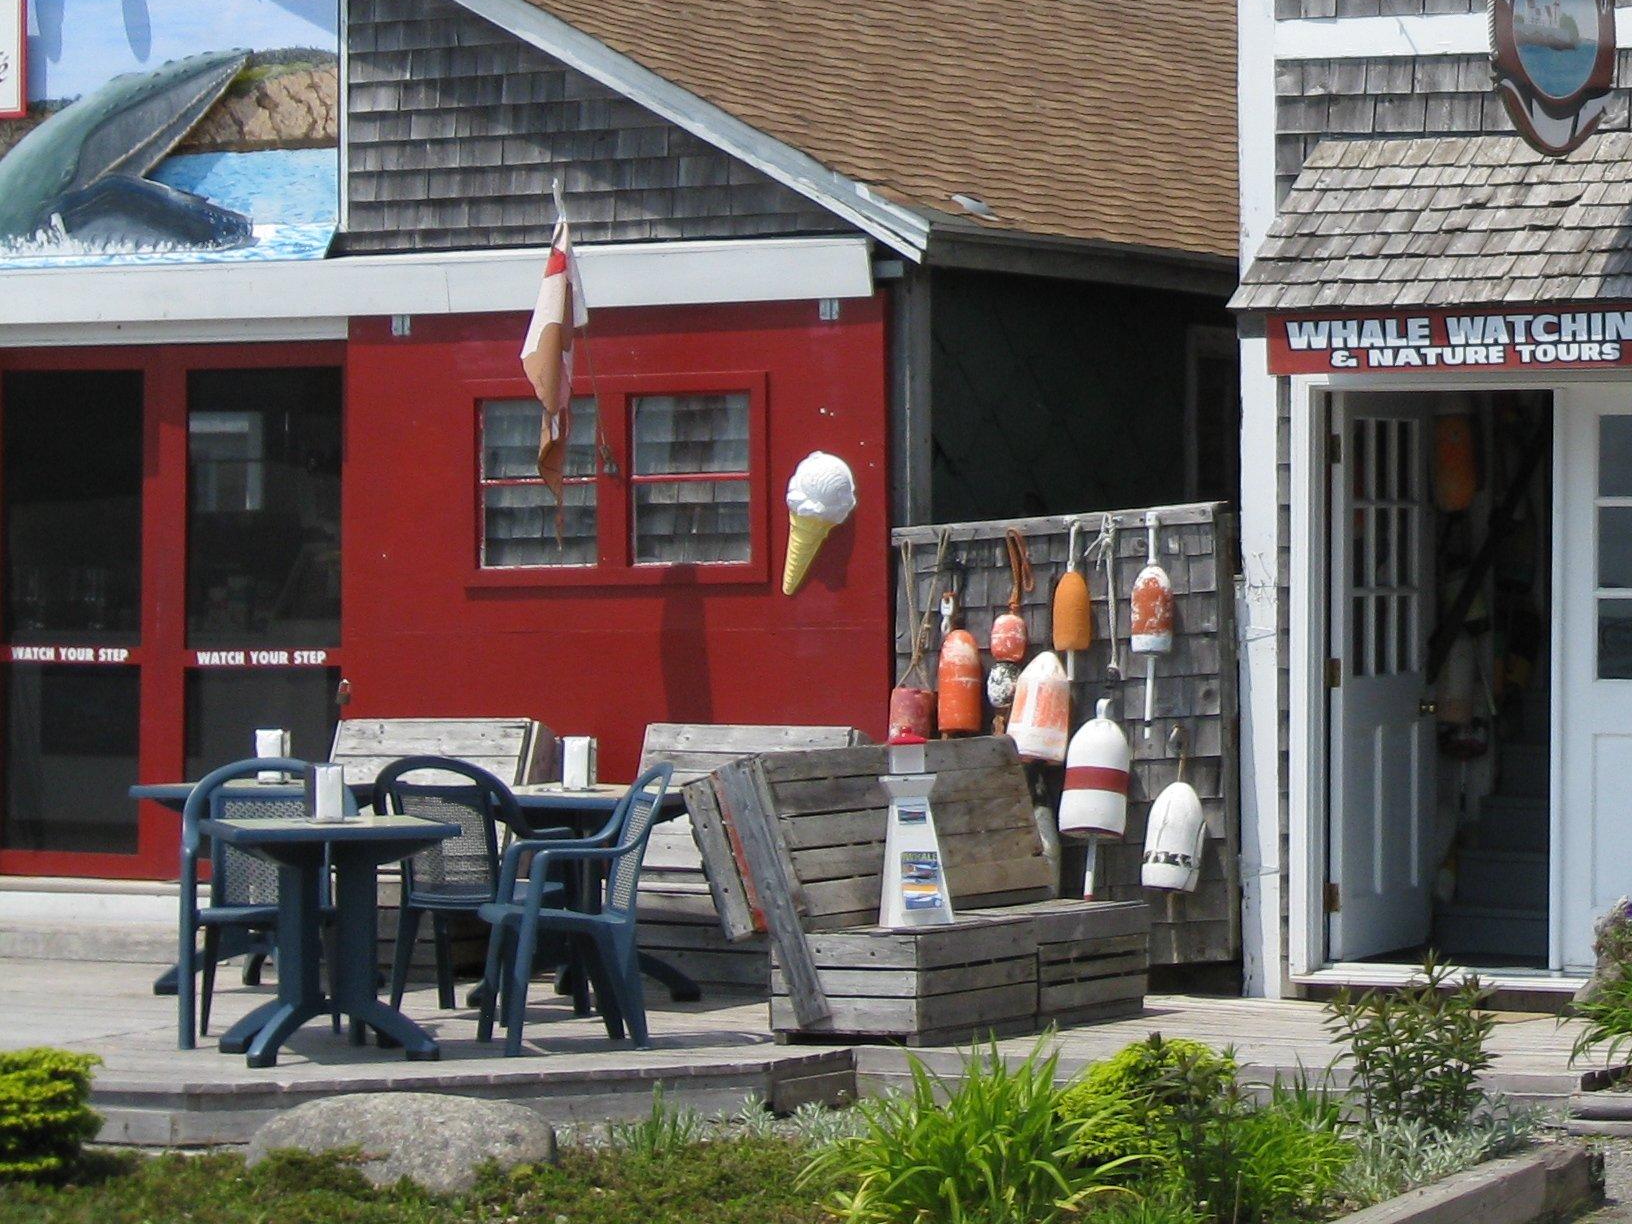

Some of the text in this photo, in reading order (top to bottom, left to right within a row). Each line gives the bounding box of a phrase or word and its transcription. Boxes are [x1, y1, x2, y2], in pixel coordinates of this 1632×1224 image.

[1285, 317, 1432, 350] WHALE
[1331, 343, 1620, 367] & NATURE TOURS
[11, 646, 130, 663] WATCH YOUR STEP
[197, 651, 327, 665] WATCH YOUR STEP
